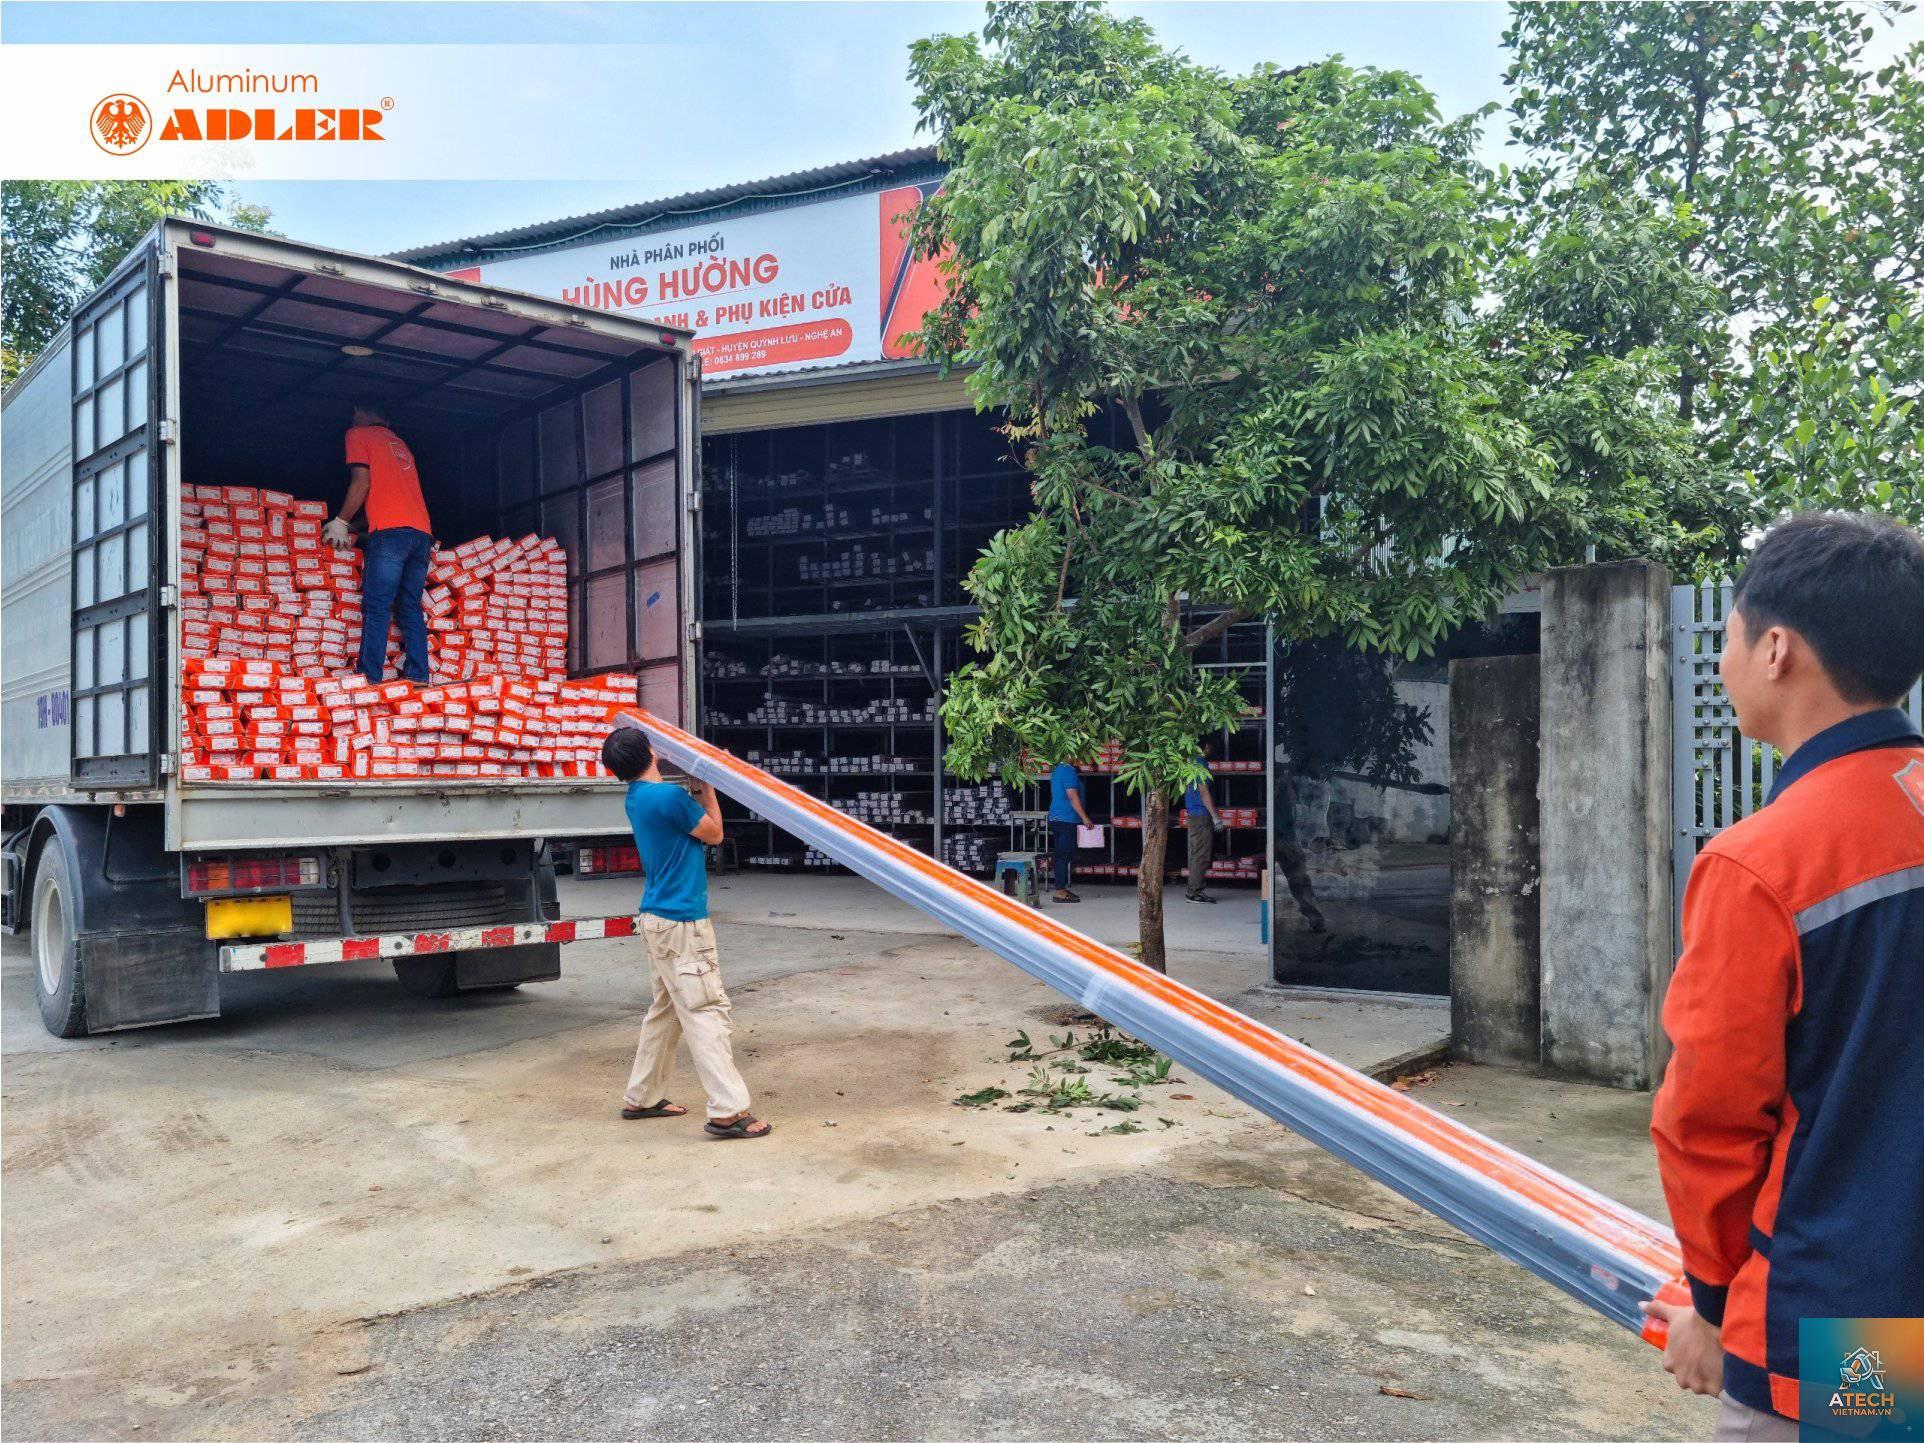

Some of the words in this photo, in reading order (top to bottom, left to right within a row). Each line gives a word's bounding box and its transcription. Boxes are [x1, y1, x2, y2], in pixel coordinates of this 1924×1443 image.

[610, 248, 640, 270] NHÀ
[644, 243, 684, 264] PHÂN
[688, 232, 724, 256] PHỐI
[562, 276, 649, 310] HÙNG
[659, 253, 780, 301] HƯỜNG
[695, 310, 709, 328] &
[715, 301, 753, 325] PHỤ
[759, 292, 805, 319] KIỆN
[811, 282, 852, 310] CỬA
[830, 327, 843, 337] AN
